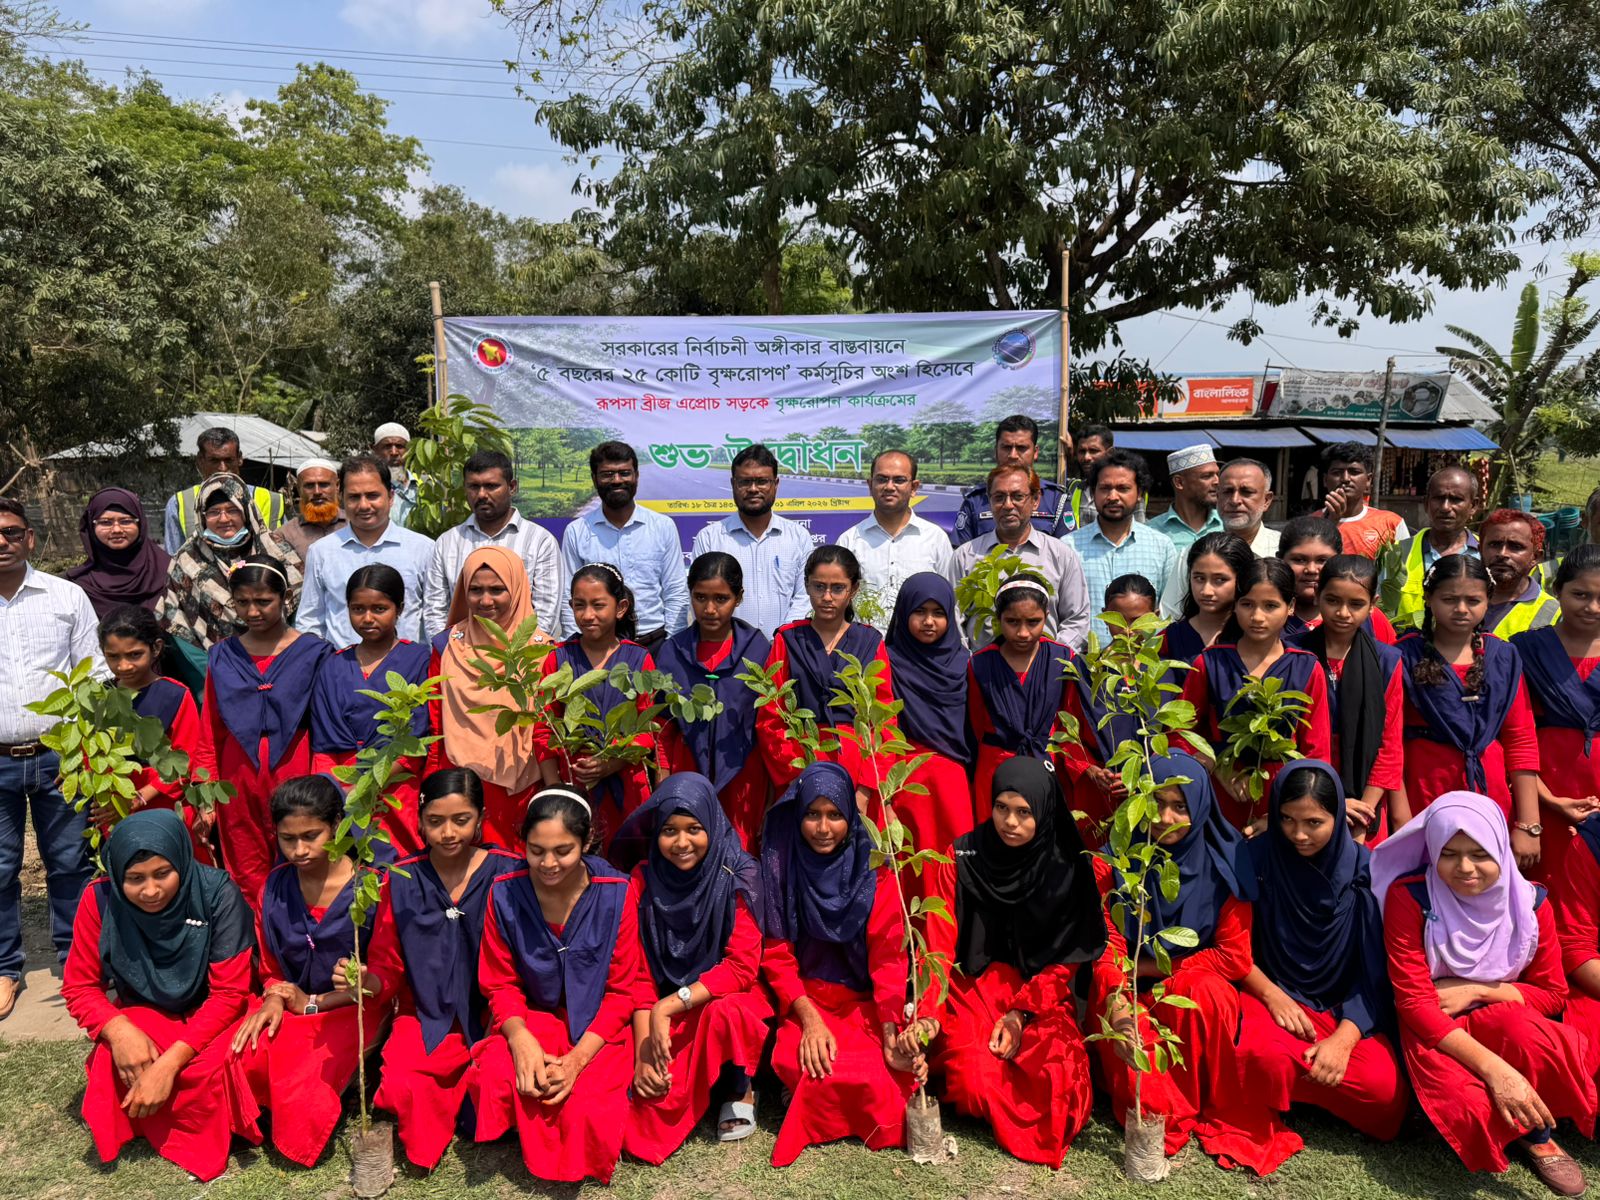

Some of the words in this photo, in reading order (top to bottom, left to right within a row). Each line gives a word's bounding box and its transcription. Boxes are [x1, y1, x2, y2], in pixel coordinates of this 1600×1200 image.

[601, 341, 679, 356] সরকারের
[685, 336, 749, 356] নির্বাচনী
[754, 335, 822, 355] অঙ্গীকার
[828, 339, 906, 355] বাস্তবায়নে
[557, 367, 615, 382] বছরের
[622, 367, 649, 384] ২৫
[655, 362, 702, 382] কোটি
[797, 361, 865, 385] কর্মসূচির
[871, 364, 910, 381] অংশ
[915, 360, 975, 378] হিসেবে
[596, 397, 638, 411] রূপসা
[641, 393, 672, 411] ব্রীজ
[676, 397, 720, 411] এপ্রোচ
[726, 397, 770, 412] সড়কে
[775, 396, 842, 414] বৃক্ষরোপন
[846, 391, 917, 408] কার্যক্রমের
[1193, 385, 1249, 398] বাংলালিংক
[649, 442, 713, 469] শুভ
